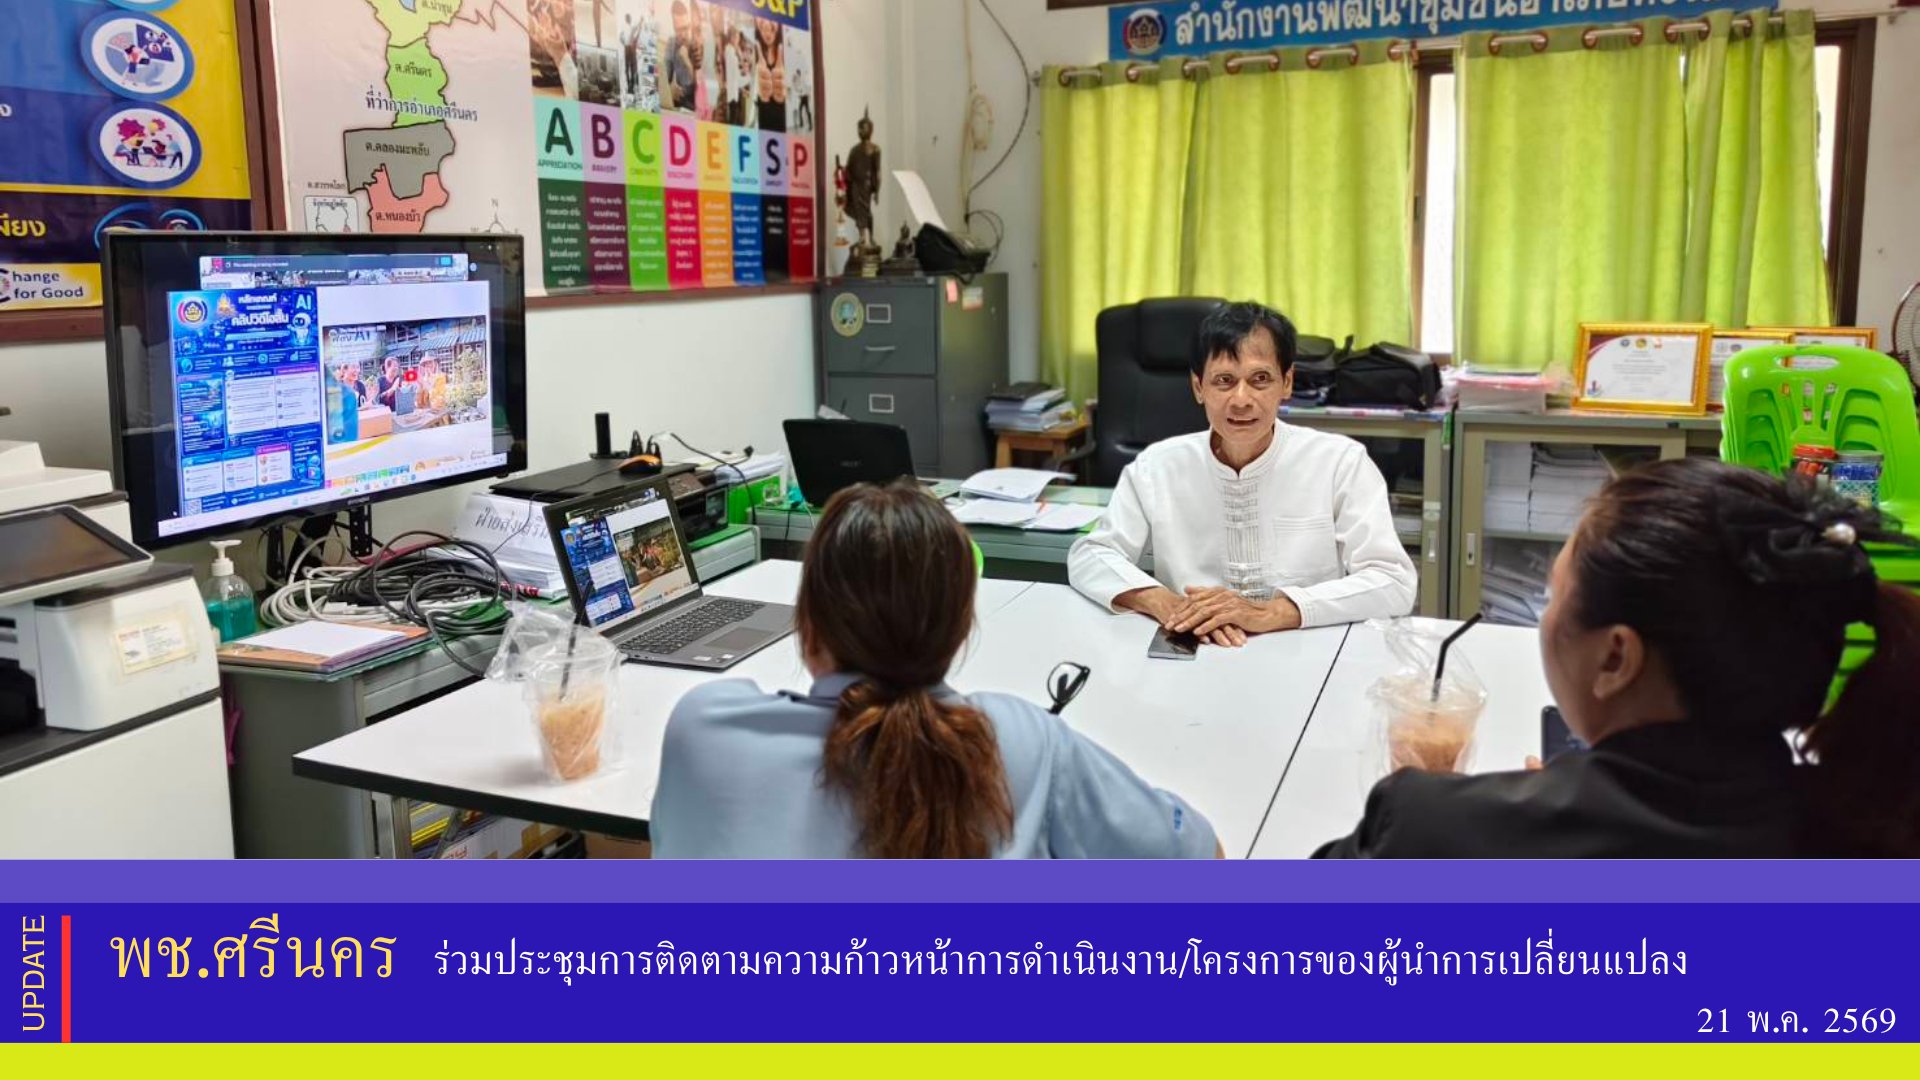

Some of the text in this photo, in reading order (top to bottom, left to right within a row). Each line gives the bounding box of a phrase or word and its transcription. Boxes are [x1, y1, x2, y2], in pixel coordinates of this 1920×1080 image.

[366, 85, 479, 122] ที่ว่าการอำเภอศรีนคร
[545, 107, 808, 178] A B C D E F S P
[0, 213, 47, 238] ียง
[14, 286, 84, 299] for Good
[296, 293, 312, 310] AI
